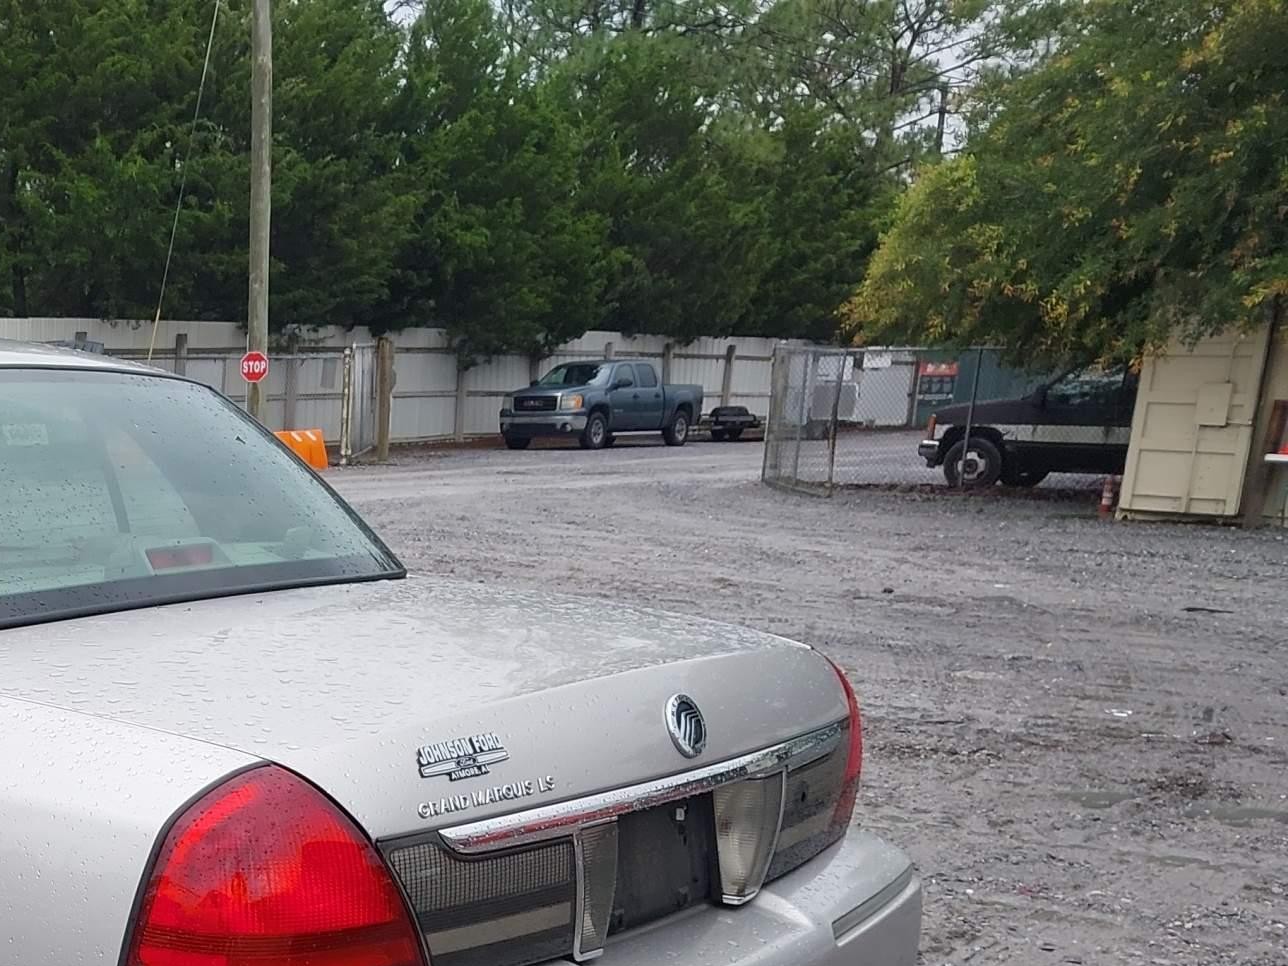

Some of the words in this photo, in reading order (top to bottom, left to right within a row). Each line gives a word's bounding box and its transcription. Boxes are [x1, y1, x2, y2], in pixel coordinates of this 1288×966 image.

[242, 360, 267, 374] STOP
[418, 738, 474, 766] JOHNSON
[472, 733, 505, 754] FORD
[417, 795, 470, 819] GRAND
[471, 780, 534, 808] MARQUIS
[538, 775, 556, 793] LS
